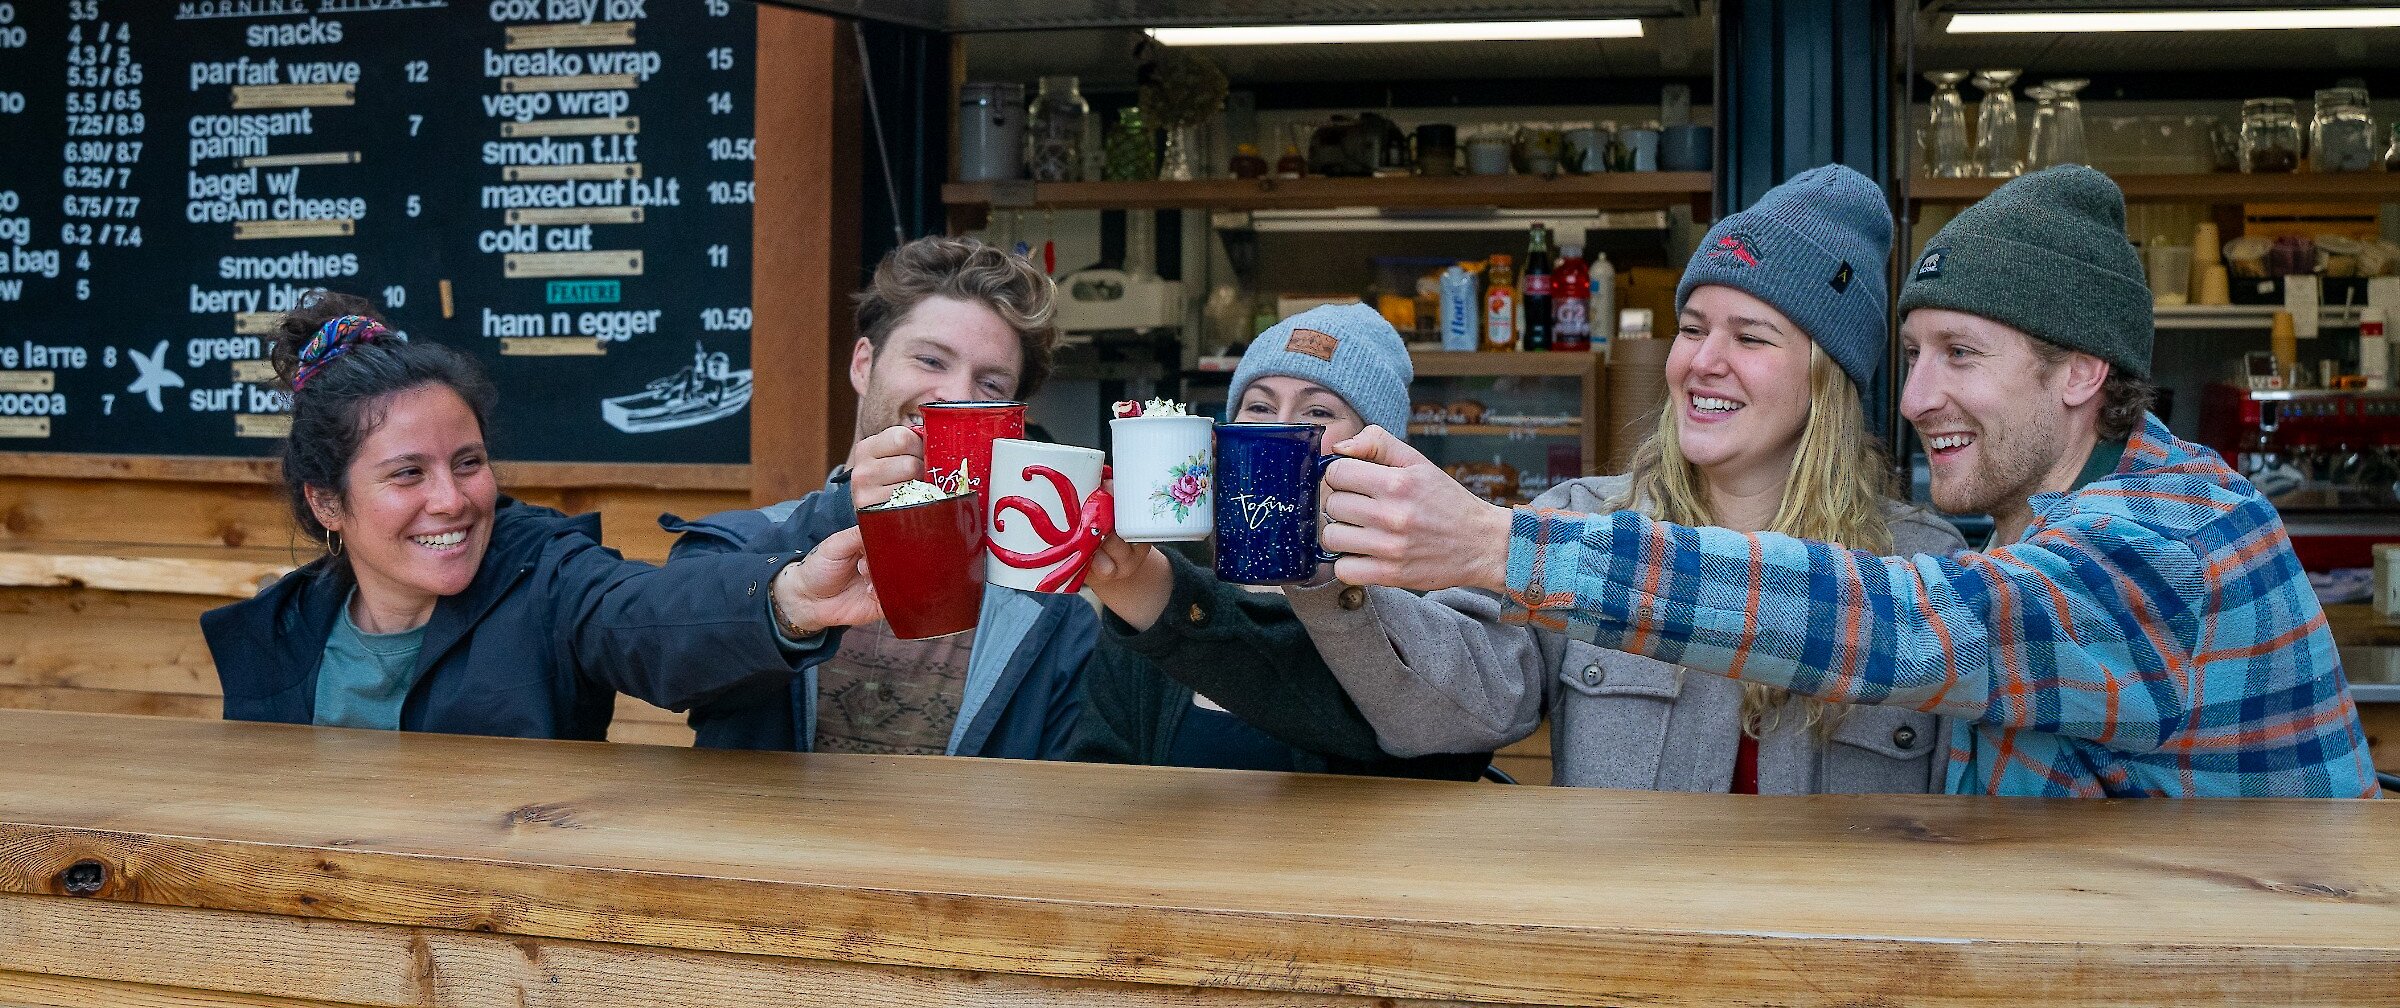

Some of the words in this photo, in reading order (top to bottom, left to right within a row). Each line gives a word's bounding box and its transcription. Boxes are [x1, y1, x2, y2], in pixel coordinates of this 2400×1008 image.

[68, 0, 99, 20] 3.5
[489, 0, 542, 21] cox
[546, 0, 598, 25] bay
[604, 0, 648, 21] lox
[706, 0, 730, 17] 15
[246, 16, 344, 48] snacks
[189, 56, 279, 92] parfait
[286, 61, 362, 84] wave
[404, 60, 430, 83] 12
[483, 48, 583, 78] breako
[587, 50, 661, 82] wrap
[706, 47, 734, 71] 15
[188, 107, 313, 137] croissant
[407, 114, 424, 137] 7
[481, 92, 552, 123] vego
[556, 90, 630, 119] wrap
[707, 91, 733, 115] 14
[188, 135, 269, 167] panini
[481, 136, 585, 166] smokin
[187, 167, 258, 200] bagel
[481, 179, 575, 209] maxed
[629, 176, 681, 207] b.l.t
[271, 192, 367, 221] cheese
[405, 194, 422, 218] 5
[478, 224, 540, 254] cold
[545, 223, 594, 251] cut
[706, 244, 730, 268] 11
[12, 244, 60, 279] bag
[75, 248, 92, 272] 4
[218, 250, 360, 281] smoothies
[75, 278, 91, 301] 5
[189, 284, 262, 313] berry
[382, 284, 407, 309] 10
[482, 307, 546, 338] ham
[551, 311, 572, 336] n
[577, 309, 663, 342] egger
[699, 306, 753, 331] 10.50
[102, 345, 118, 369] 8
[187, 337, 262, 368] green
[0, 392, 67, 416] ocoa
[101, 393, 116, 416] 7
[189, 381, 244, 412] surf
[1230, 494, 1295, 530] Tofino
